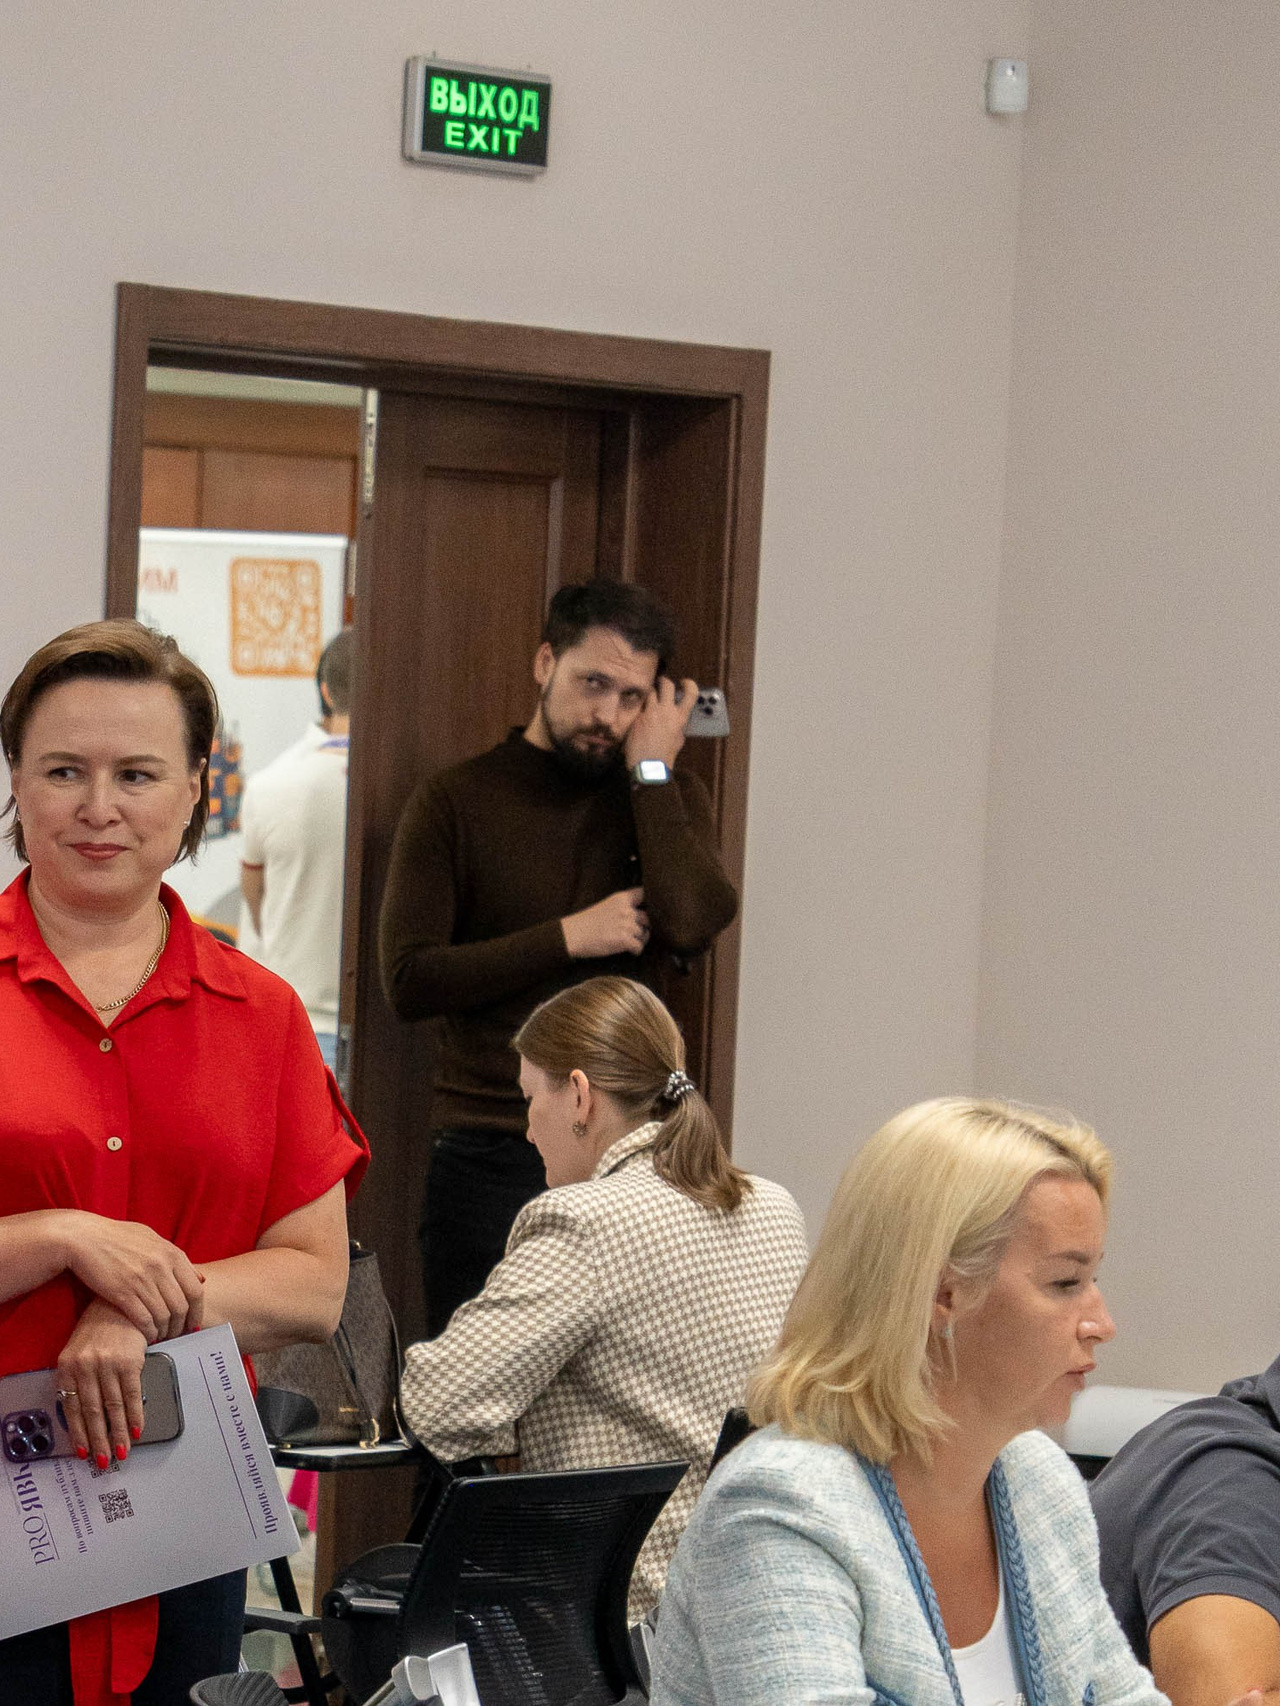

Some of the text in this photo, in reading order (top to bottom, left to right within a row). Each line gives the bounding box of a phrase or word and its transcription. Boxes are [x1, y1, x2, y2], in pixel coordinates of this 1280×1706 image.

[430, 76, 540, 132] ВЫХОД
[444, 120, 524, 156] EXIT
[210, 1351, 232, 1391] нами!
[229, 1405, 251, 1450] вместе
[13, 1461, 43, 1512] ЯВК
[245, 1453, 278, 1534] Проявляйся
